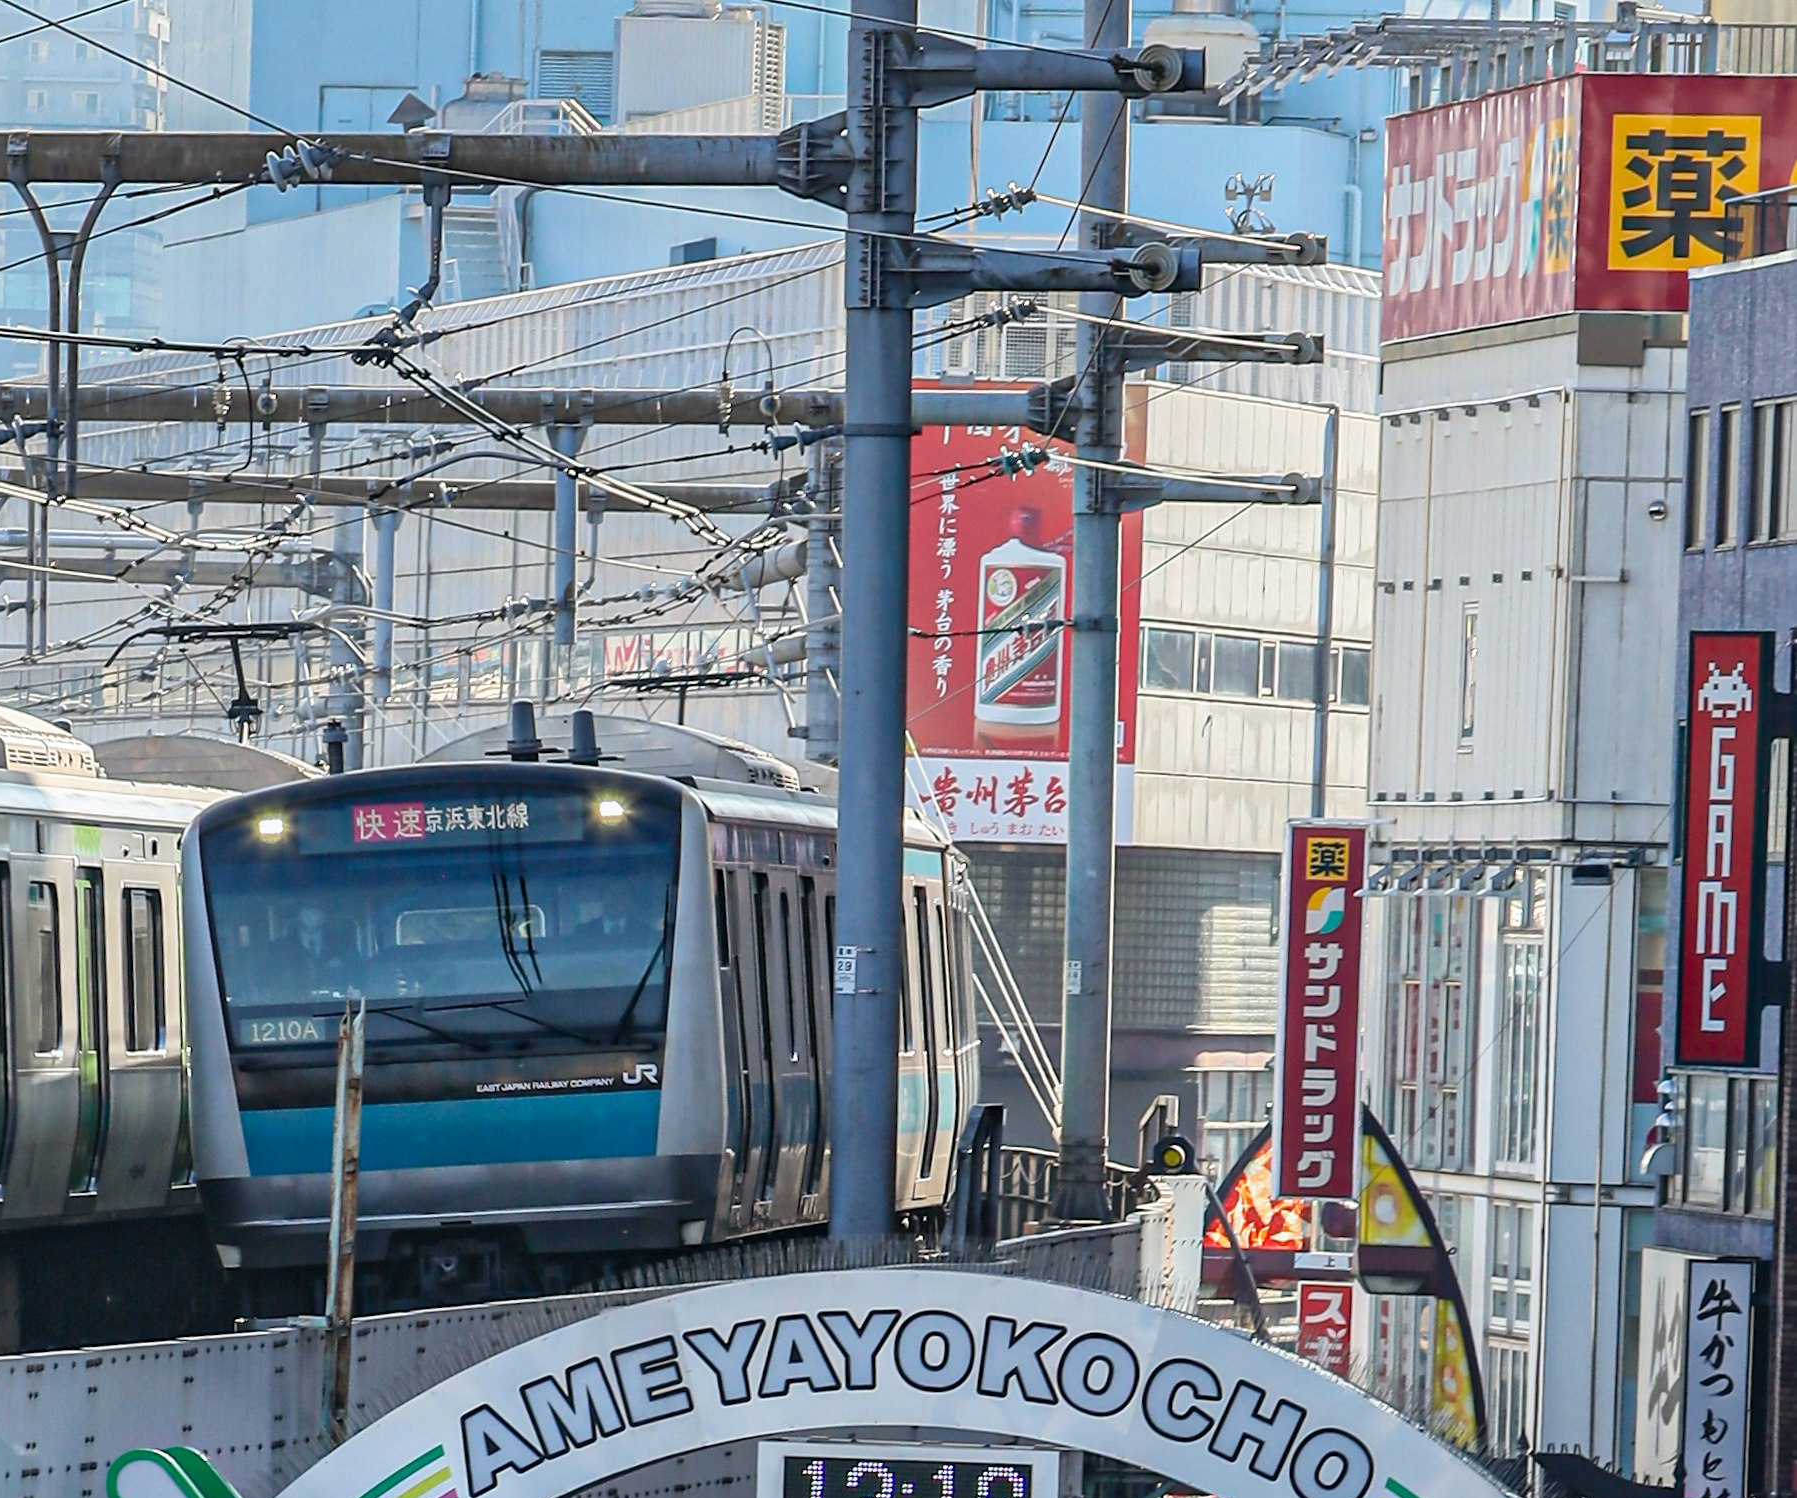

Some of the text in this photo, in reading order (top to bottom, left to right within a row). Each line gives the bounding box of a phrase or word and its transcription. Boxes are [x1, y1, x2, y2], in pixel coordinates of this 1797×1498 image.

[1620, 129, 1746, 258] 薬
[1388, 138, 1519, 297] サンドラッグ
[931, 588, 955, 698] 茅台の香り
[356, 801, 530, 840] 快速 京浜東北線
[969, 822, 999, 836] しゅう
[1007, 822, 1033, 836] まお
[1038, 822, 1065, 837] たい
[1310, 841, 1347, 878] 薬
[1696, 726, 1738, 1032] GAME
[838, 960, 853, 972] 29
[250, 1022, 319, 1042] 1210A
[623, 1064, 658, 1085] JR
[1297, 942, 1344, 1190] サンドラッグ
